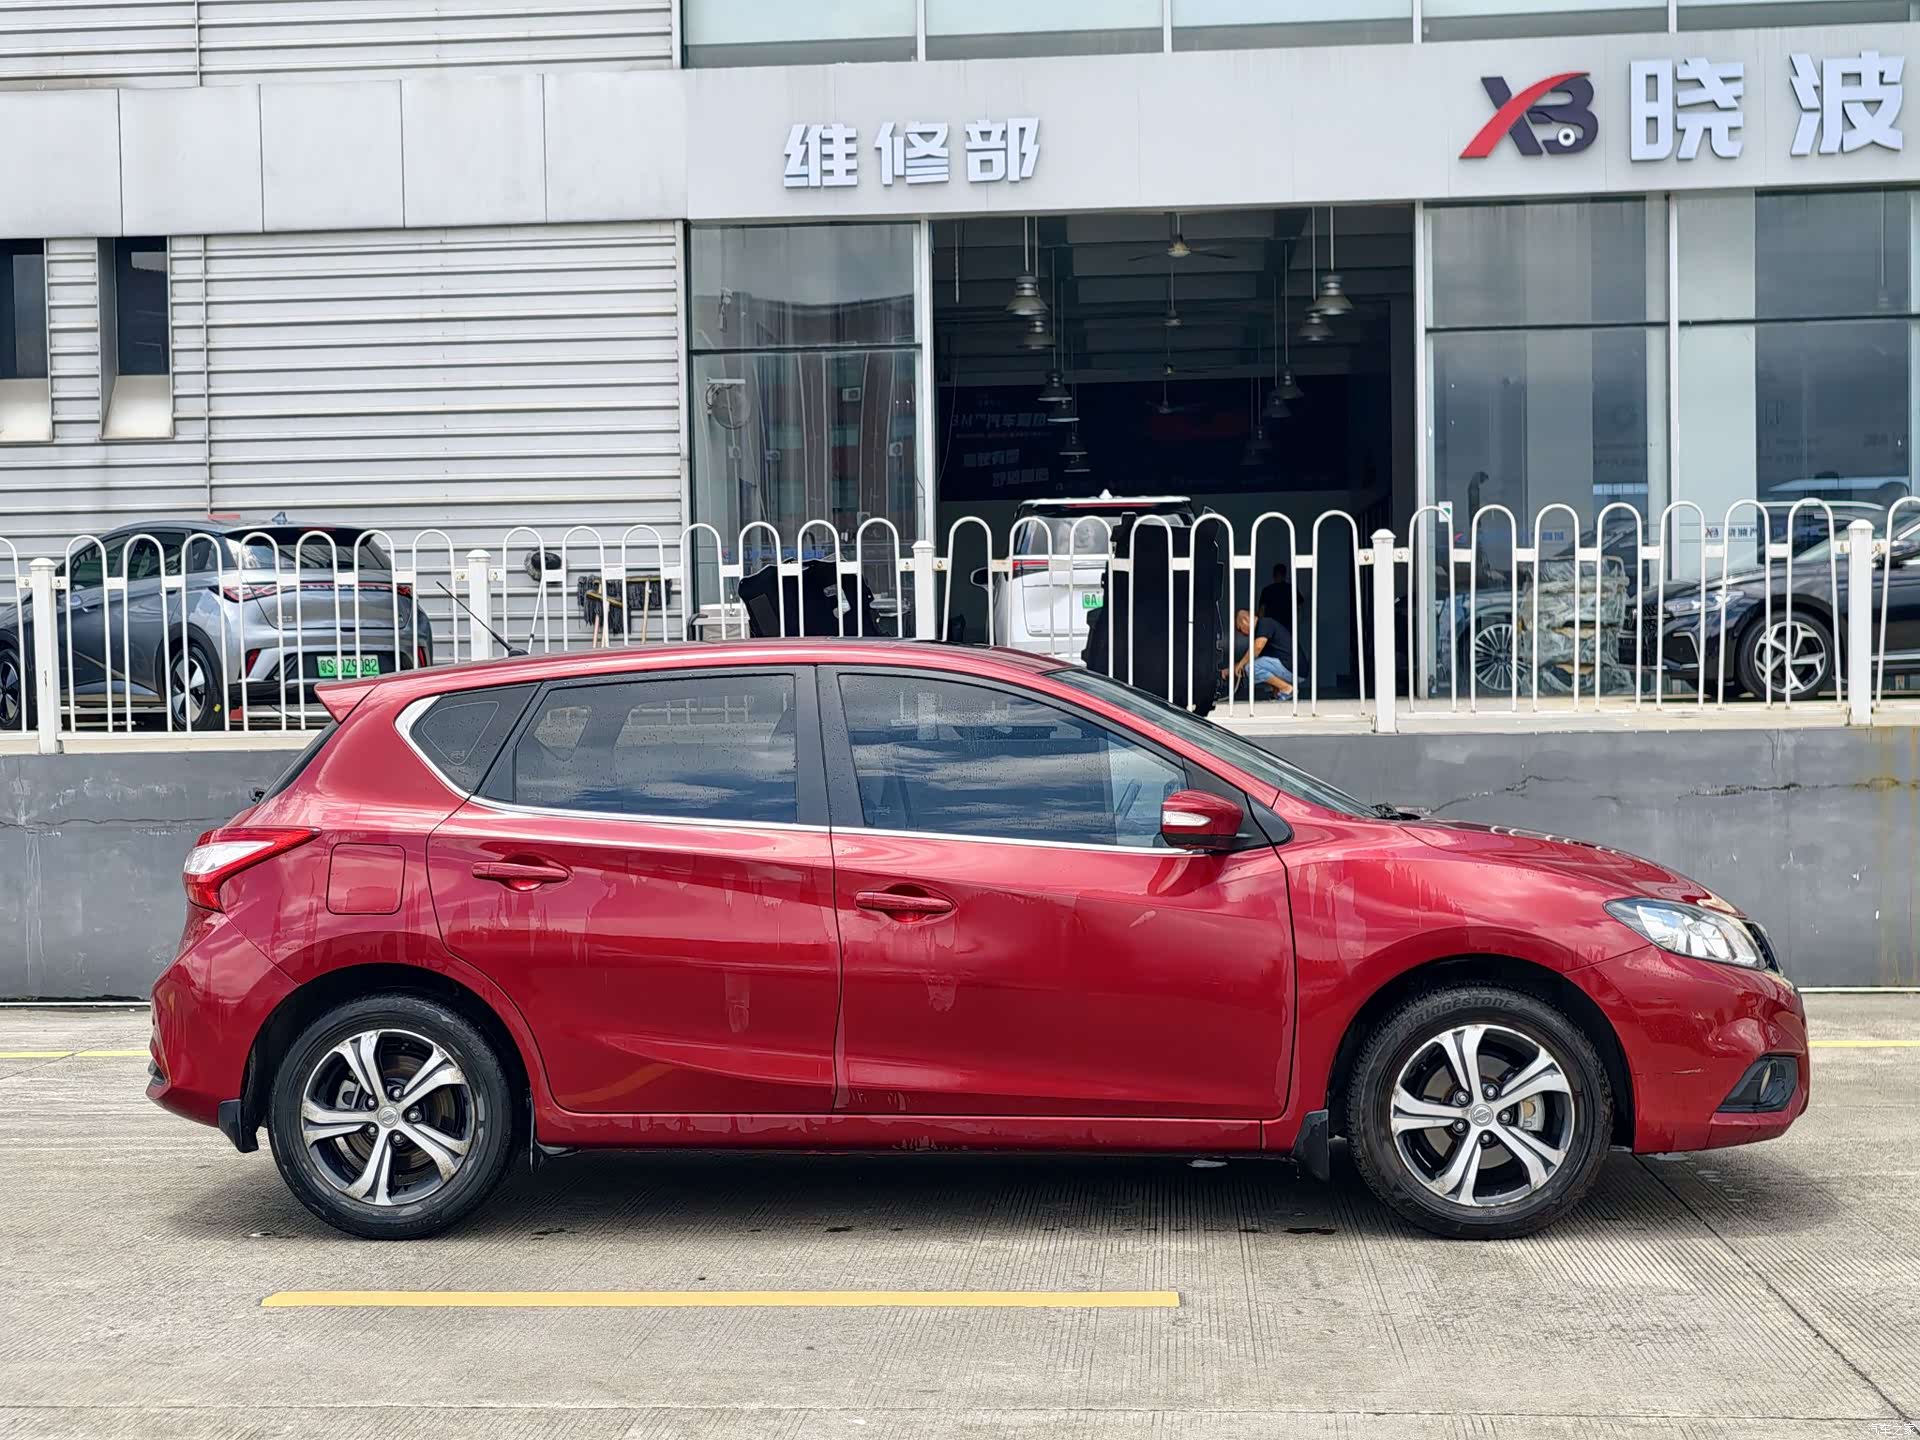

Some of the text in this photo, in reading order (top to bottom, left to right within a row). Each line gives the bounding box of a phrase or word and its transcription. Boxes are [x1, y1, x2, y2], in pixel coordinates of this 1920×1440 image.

[1628, 50, 1905, 162] 晓波
[783, 117, 1040, 189] 维修部
